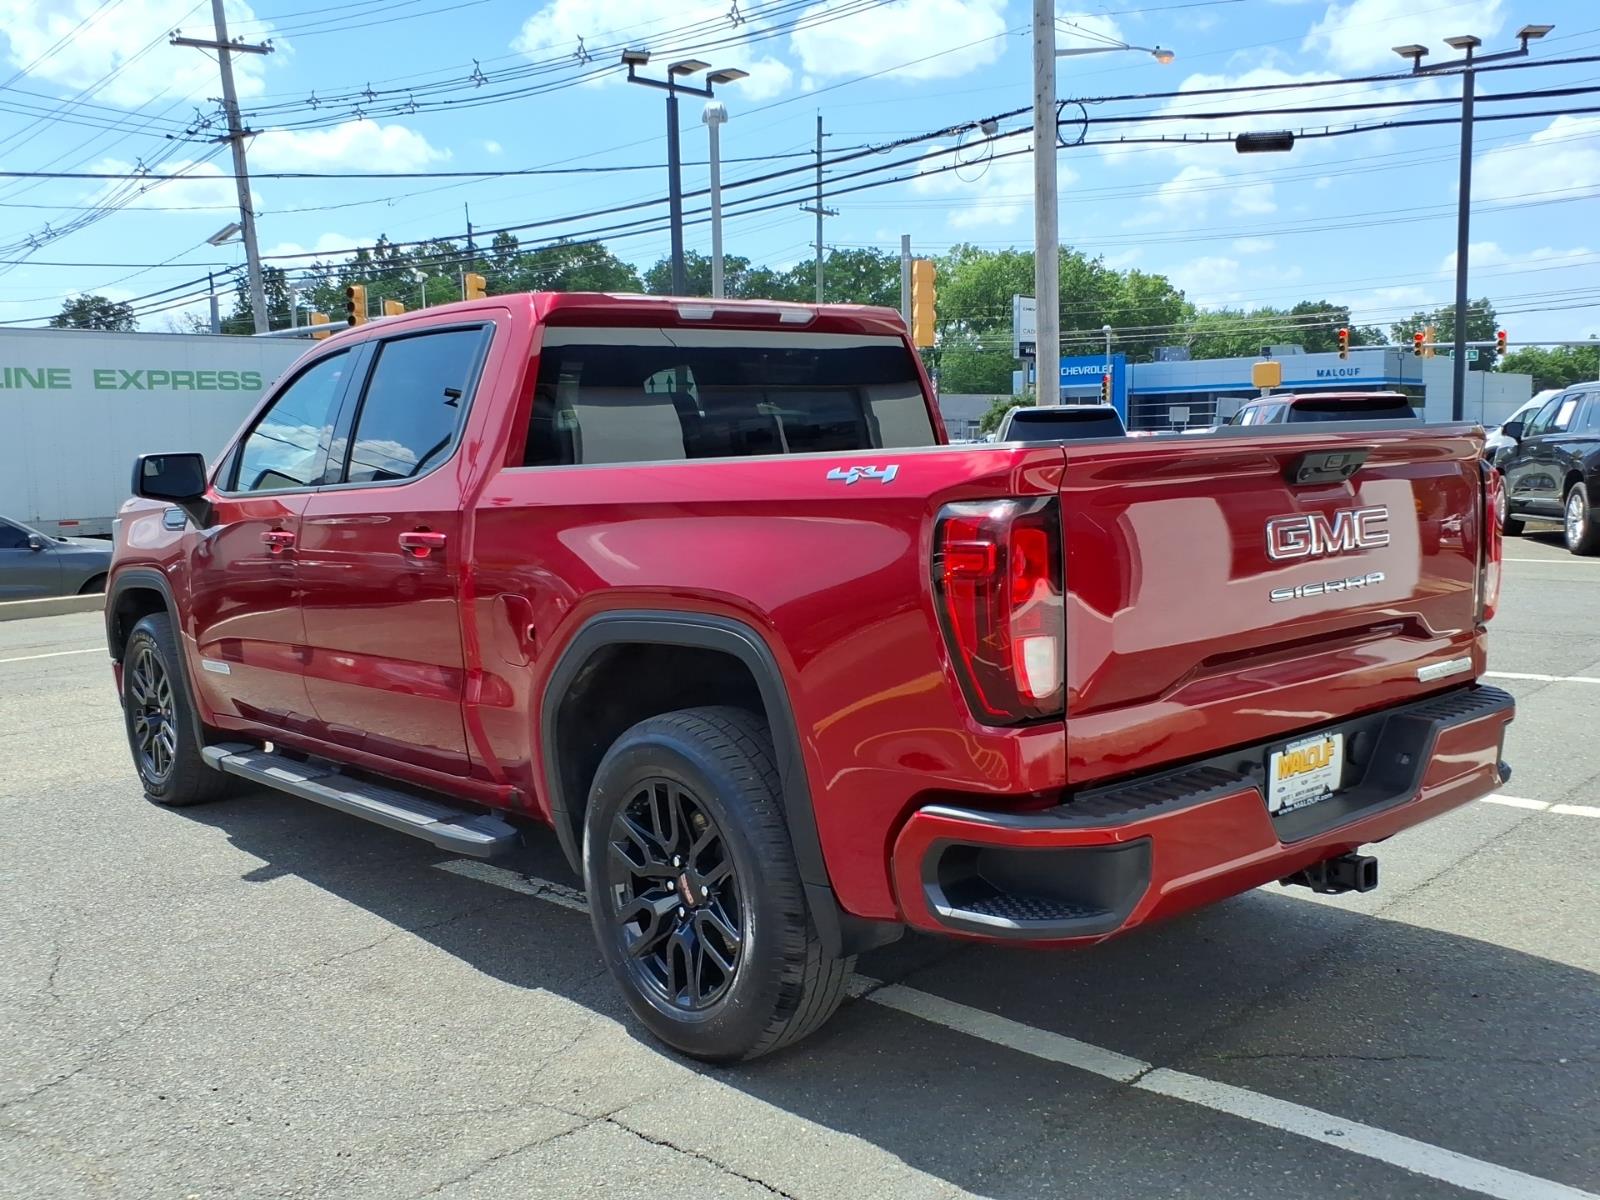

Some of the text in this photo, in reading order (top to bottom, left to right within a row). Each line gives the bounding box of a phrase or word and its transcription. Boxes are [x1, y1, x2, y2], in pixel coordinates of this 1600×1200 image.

[0, 367, 263, 391] INE EXPRESS
[1060, 364, 1114, 376] CHEVROLET
[1316, 367, 1361, 377] MALOUF
[1266, 504, 1390, 560] GMC
[1269, 571, 1386, 602] SIERRA
[1278, 742, 1335, 780] MALOUF
